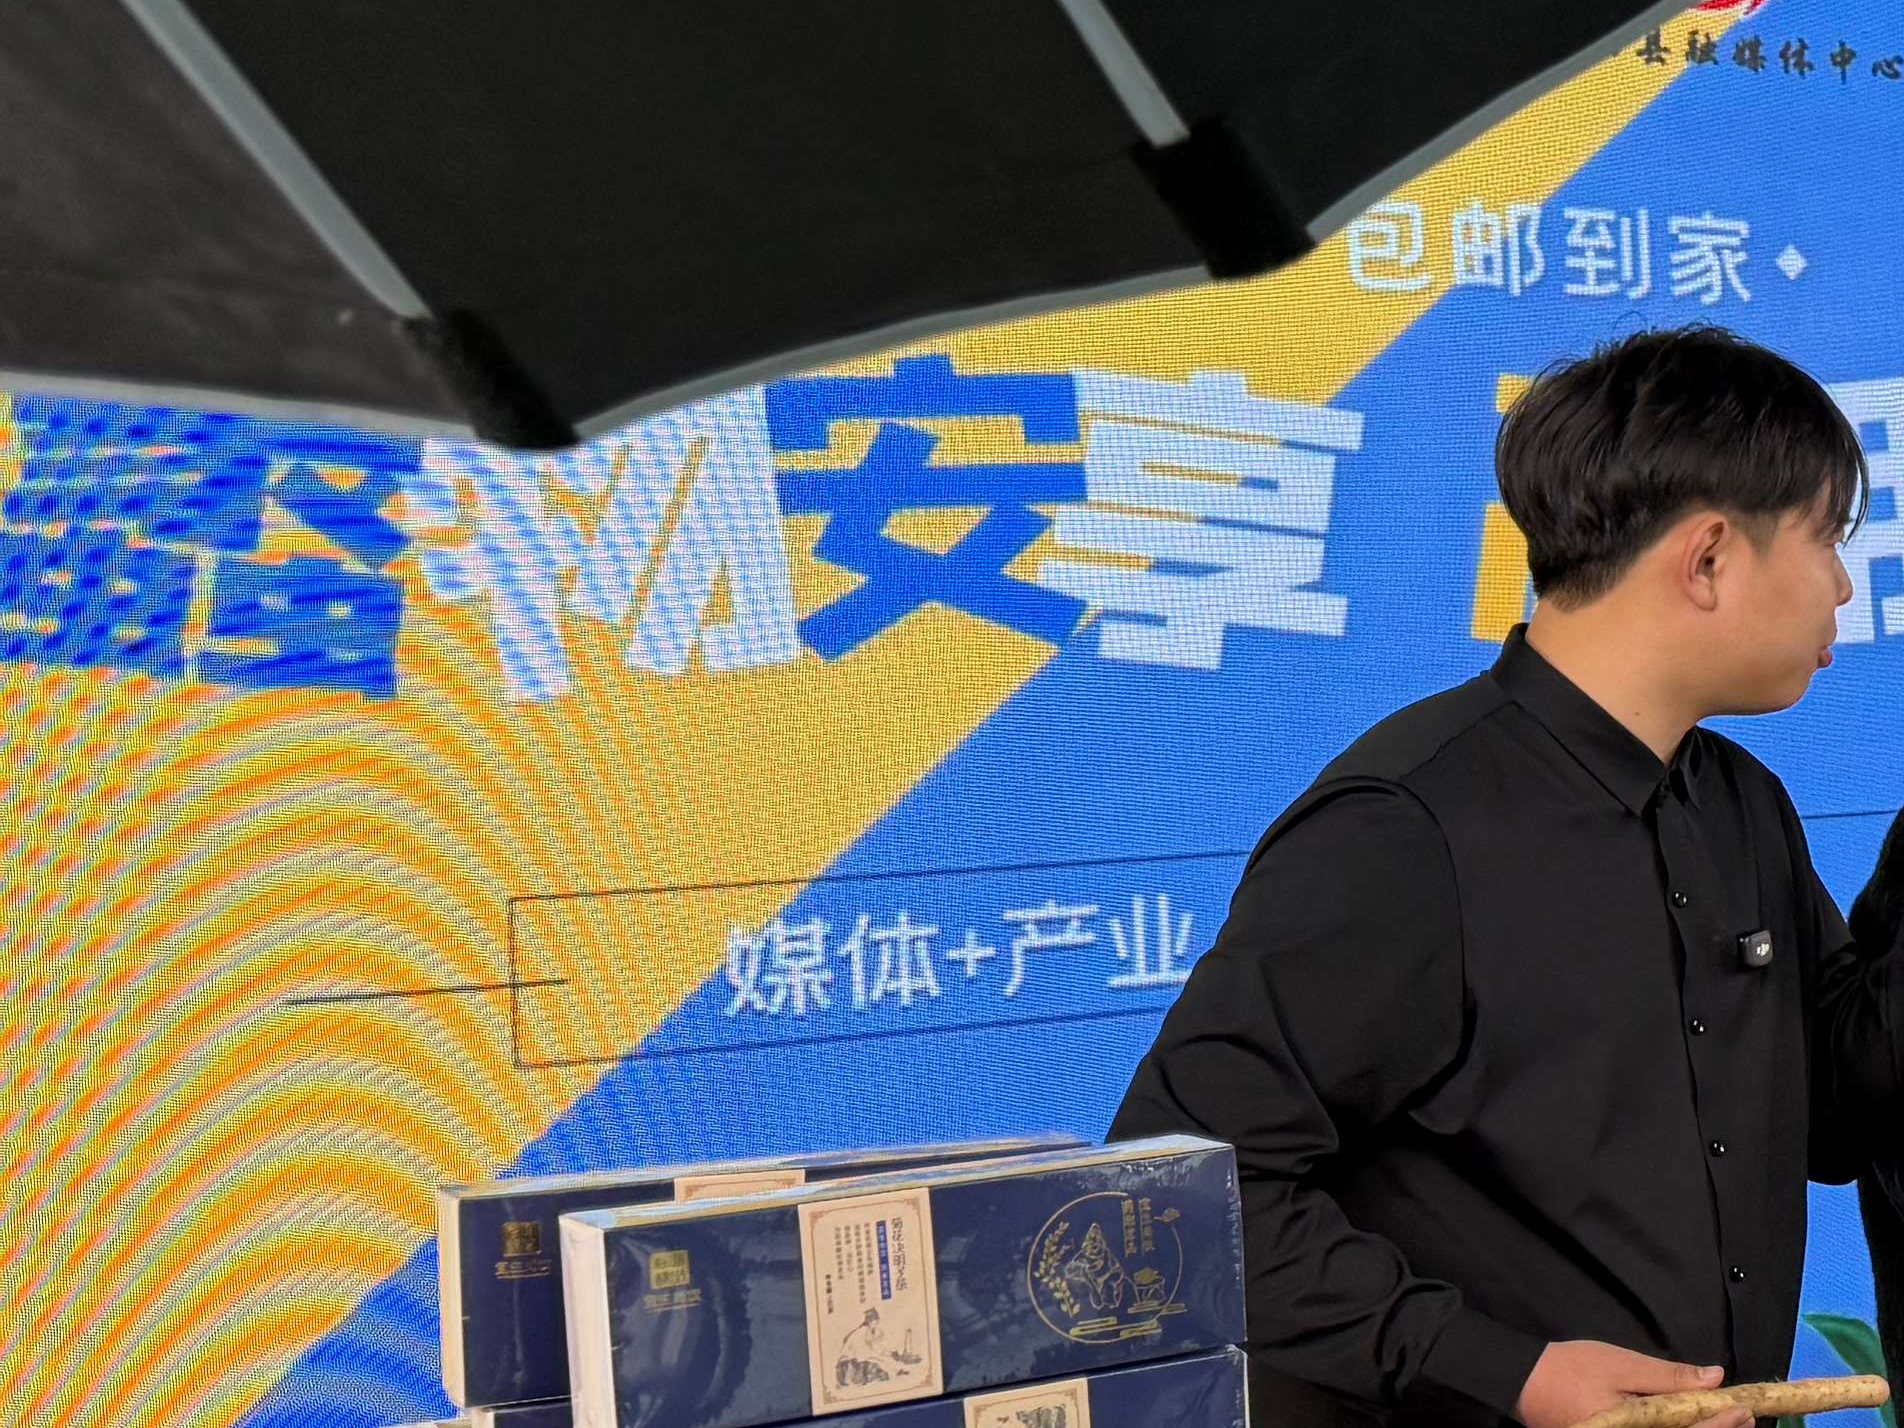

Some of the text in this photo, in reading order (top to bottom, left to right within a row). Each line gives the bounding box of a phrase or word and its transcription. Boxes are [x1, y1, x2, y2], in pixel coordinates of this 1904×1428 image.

[1346, 198, 1752, 306] 包邮到家
[724, 893, 1194, 1018] 媒体+产业
